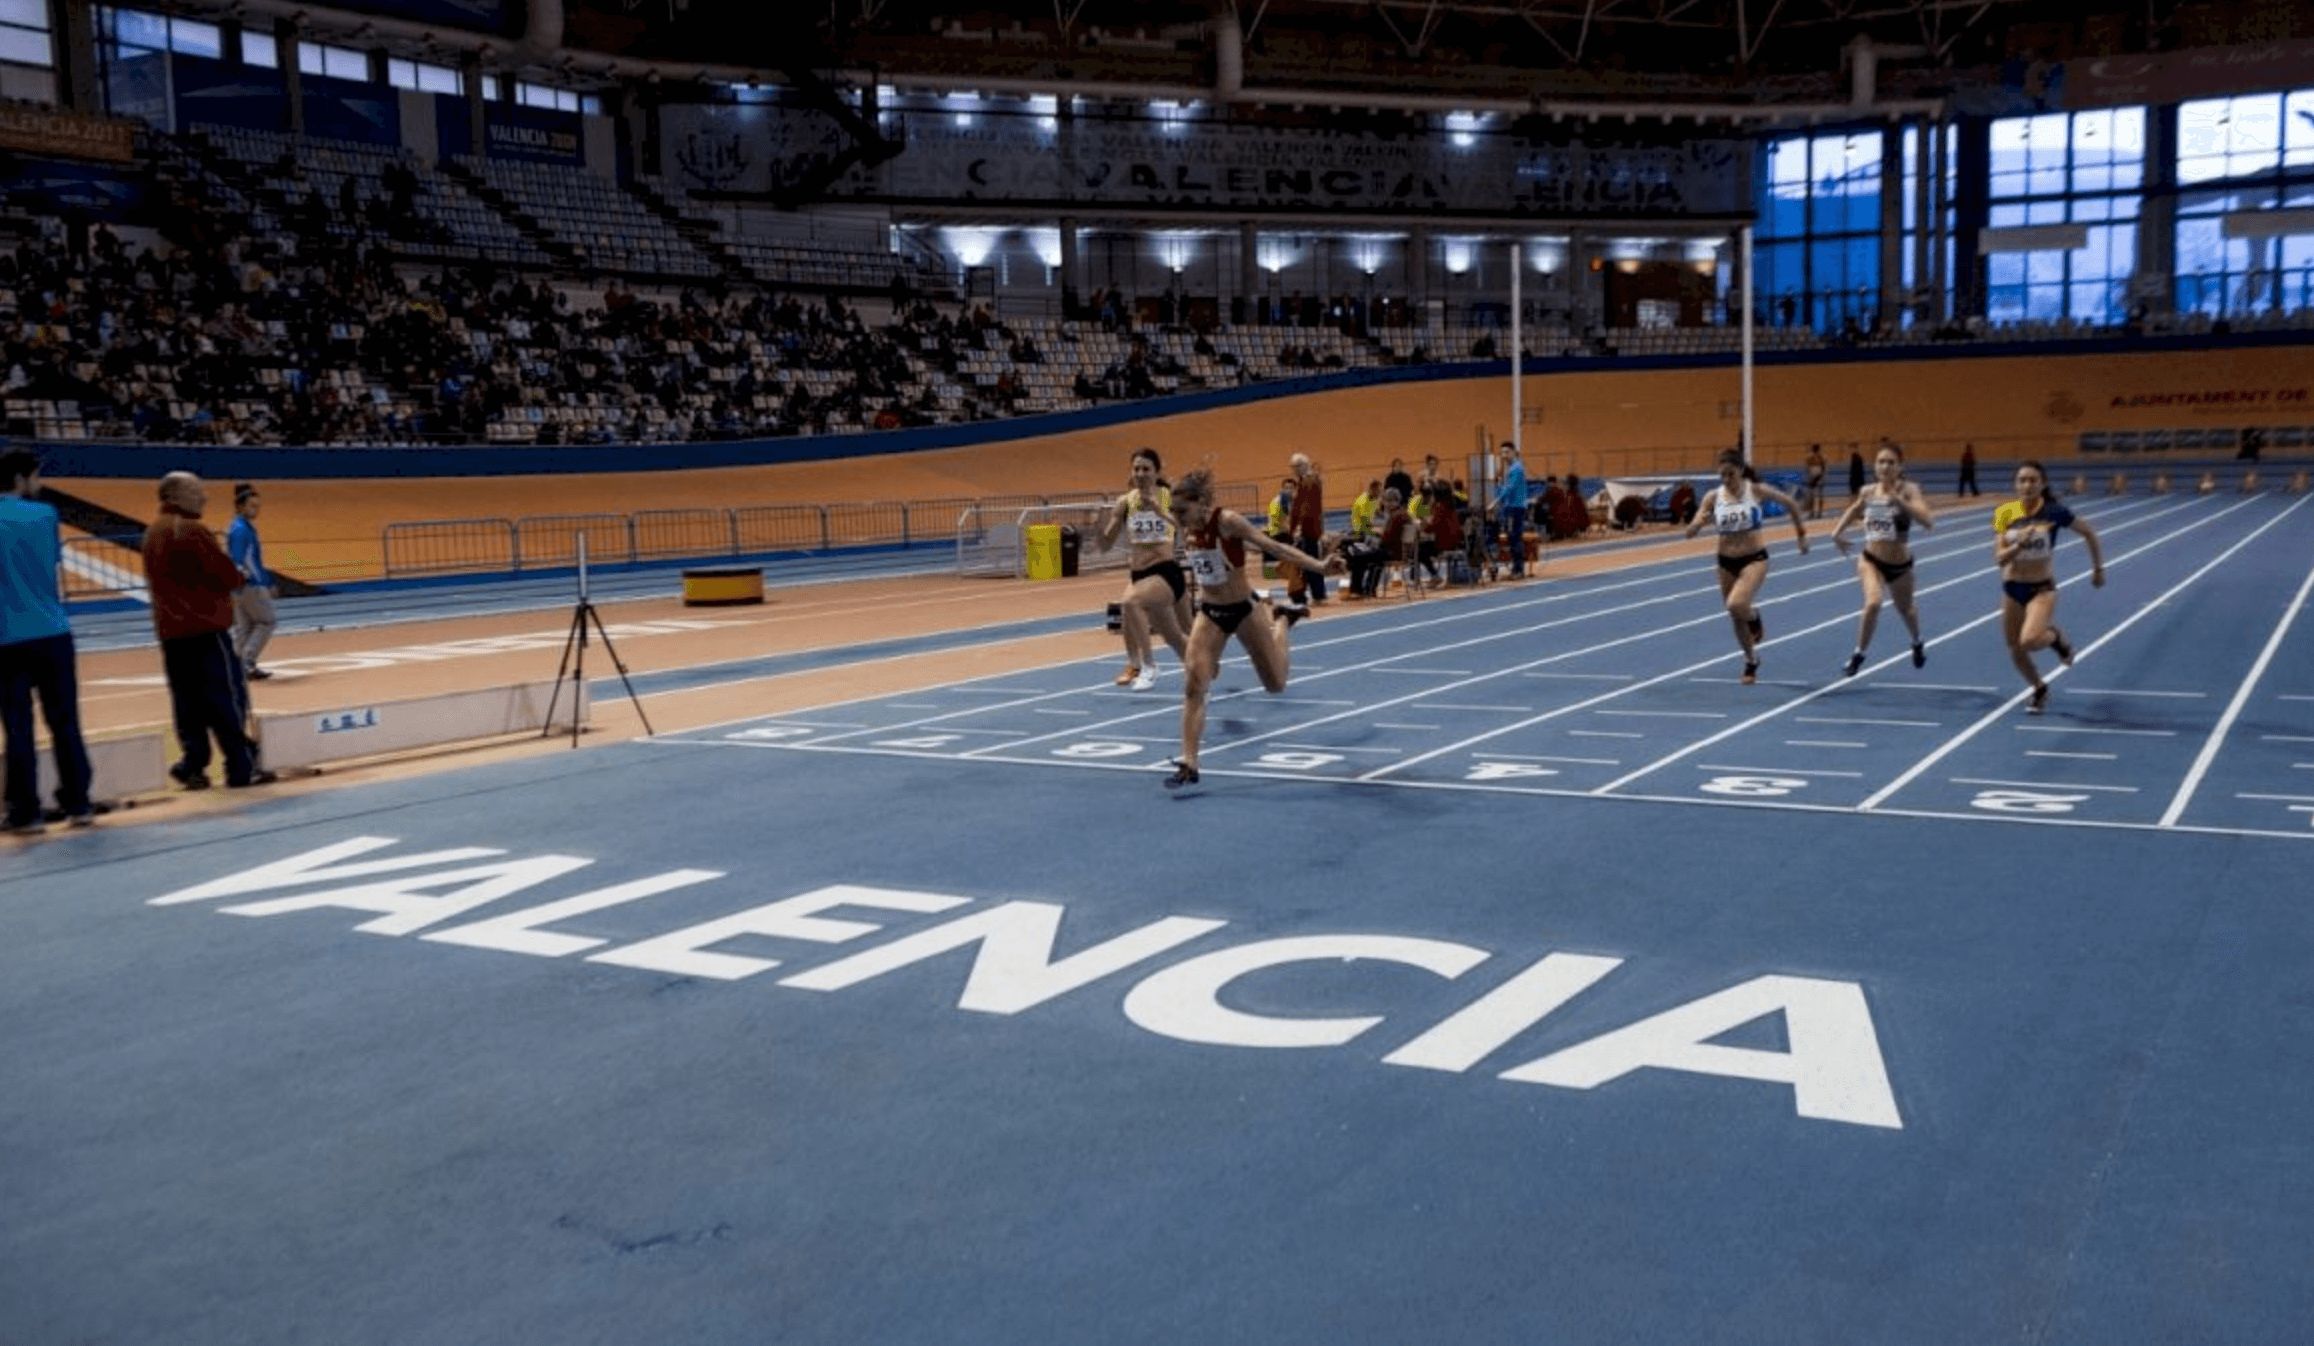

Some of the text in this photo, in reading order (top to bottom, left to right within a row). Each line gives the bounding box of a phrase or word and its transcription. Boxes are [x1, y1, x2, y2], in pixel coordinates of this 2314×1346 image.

[489, 124, 548, 146] VALENCIA
[1133, 519, 1166, 534] 235
[1699, 776, 1809, 796] 3
[1970, 790, 2093, 813] 2
[147, 835, 1905, 1131] VALENCIA
